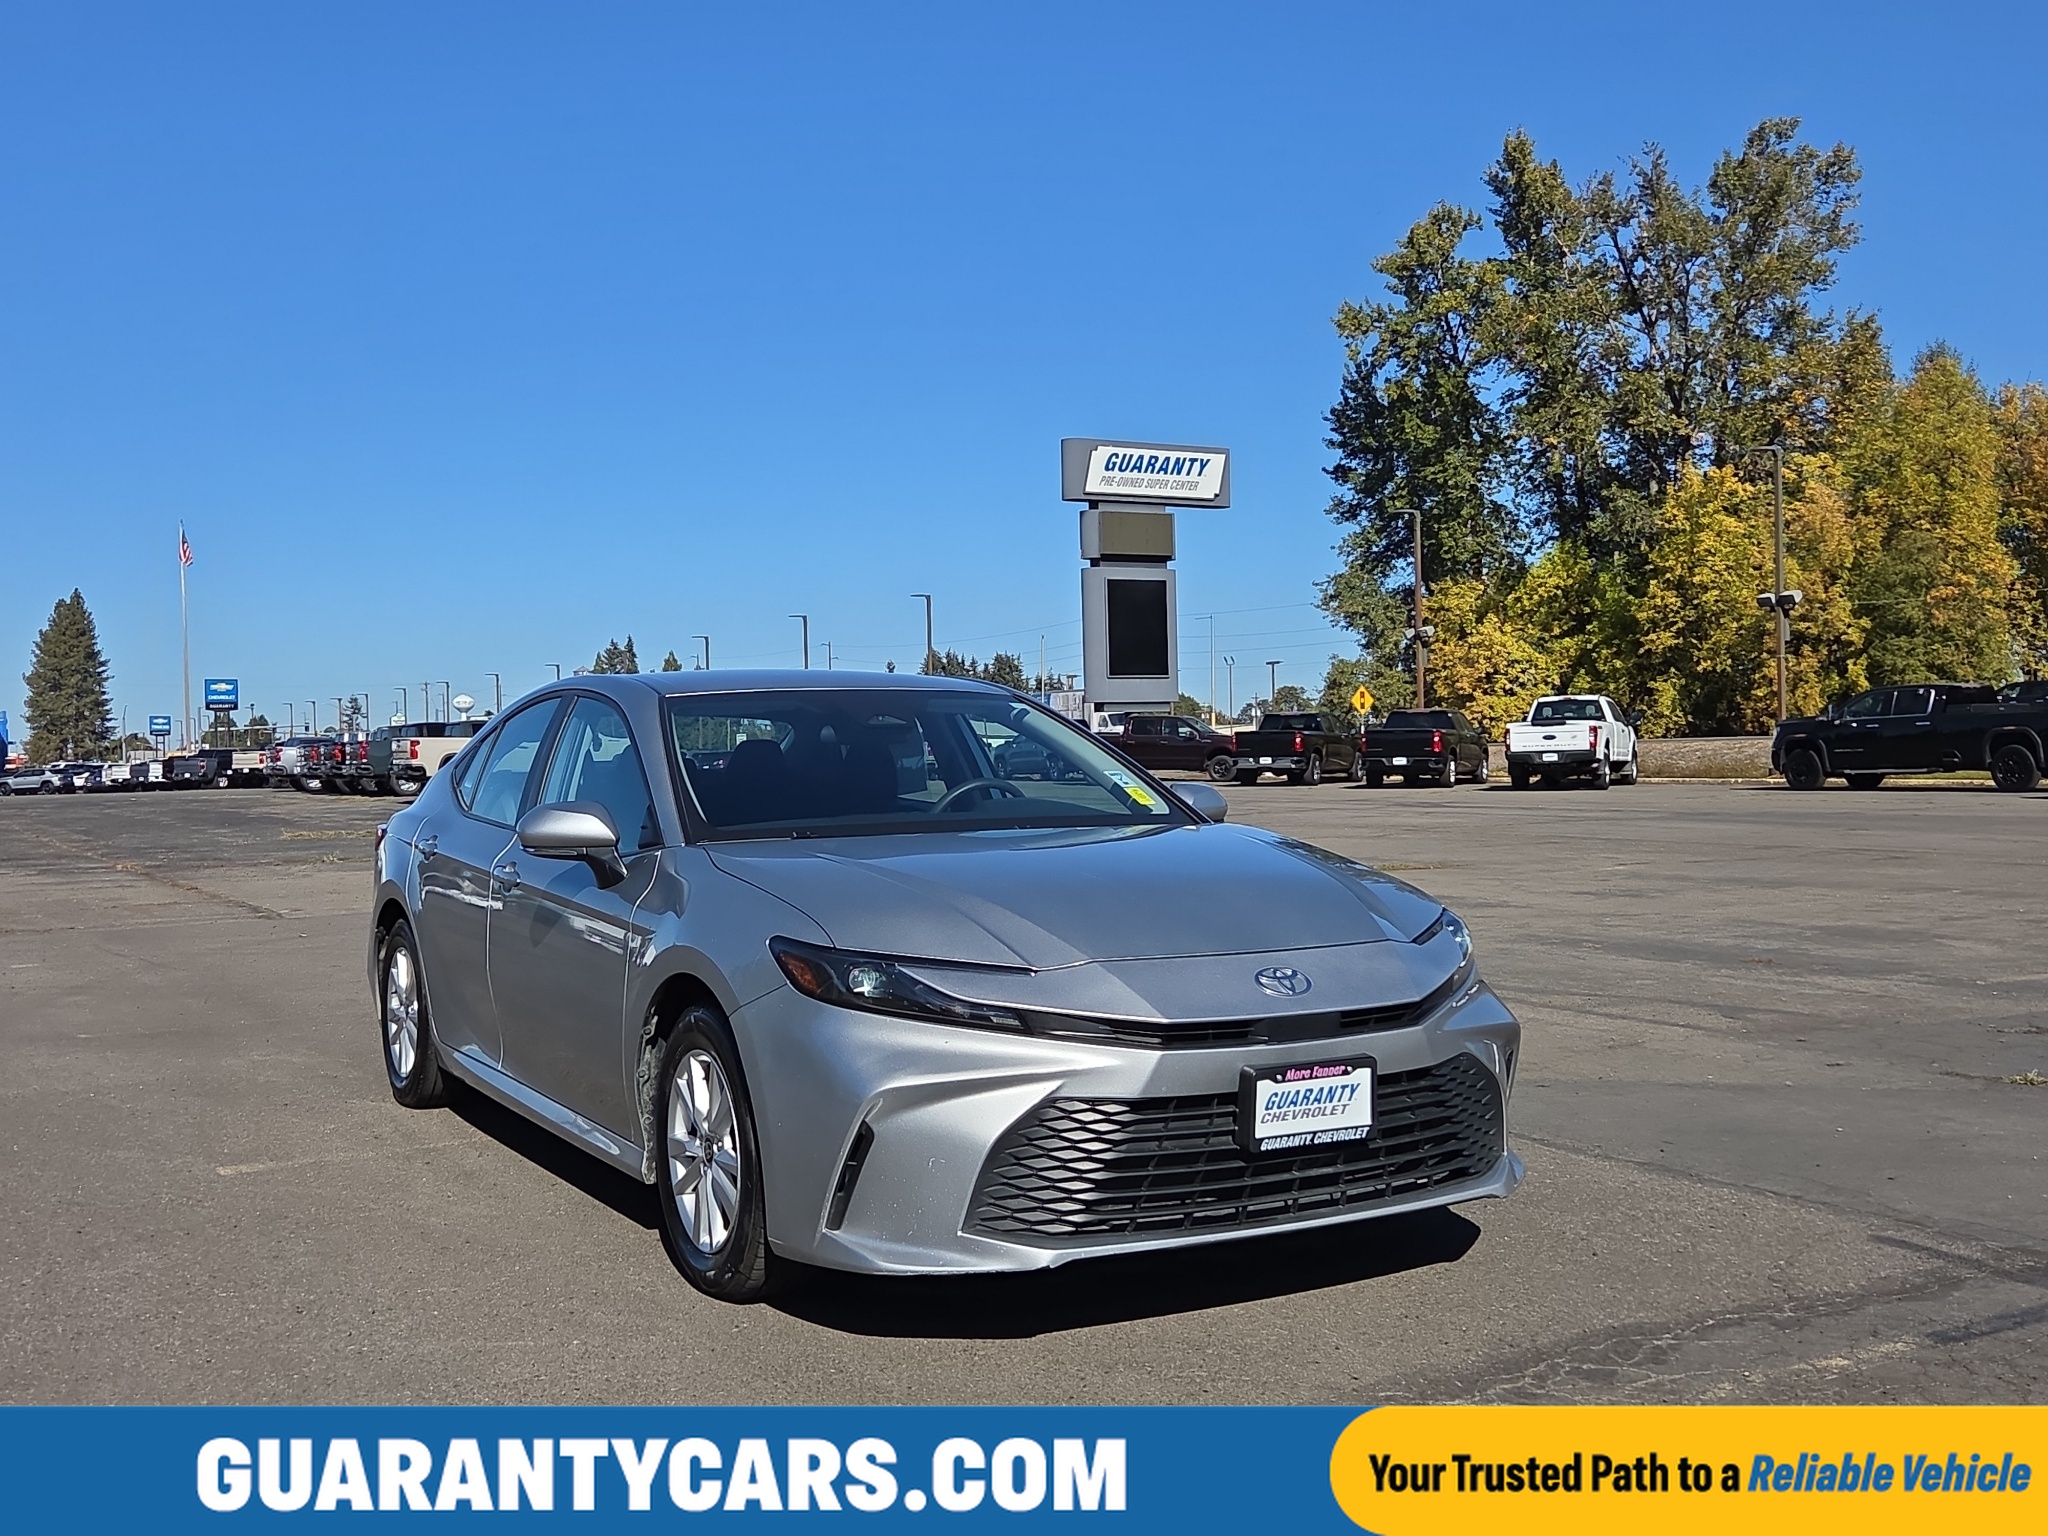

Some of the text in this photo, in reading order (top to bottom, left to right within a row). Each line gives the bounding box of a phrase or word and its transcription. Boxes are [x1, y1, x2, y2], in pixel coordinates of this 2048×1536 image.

[1104, 452, 1211, 477] GUARANTY
[1099, 476, 1200, 492] PRE-OWNED SUPER CENTER
[1285, 1068, 1311, 1081] More
[1264, 1083, 1361, 1111] GUARANTY
[1260, 1103, 1350, 1124] CHEVROLET
[1260, 1127, 1370, 1151] GUARANTY CHEVROLET
